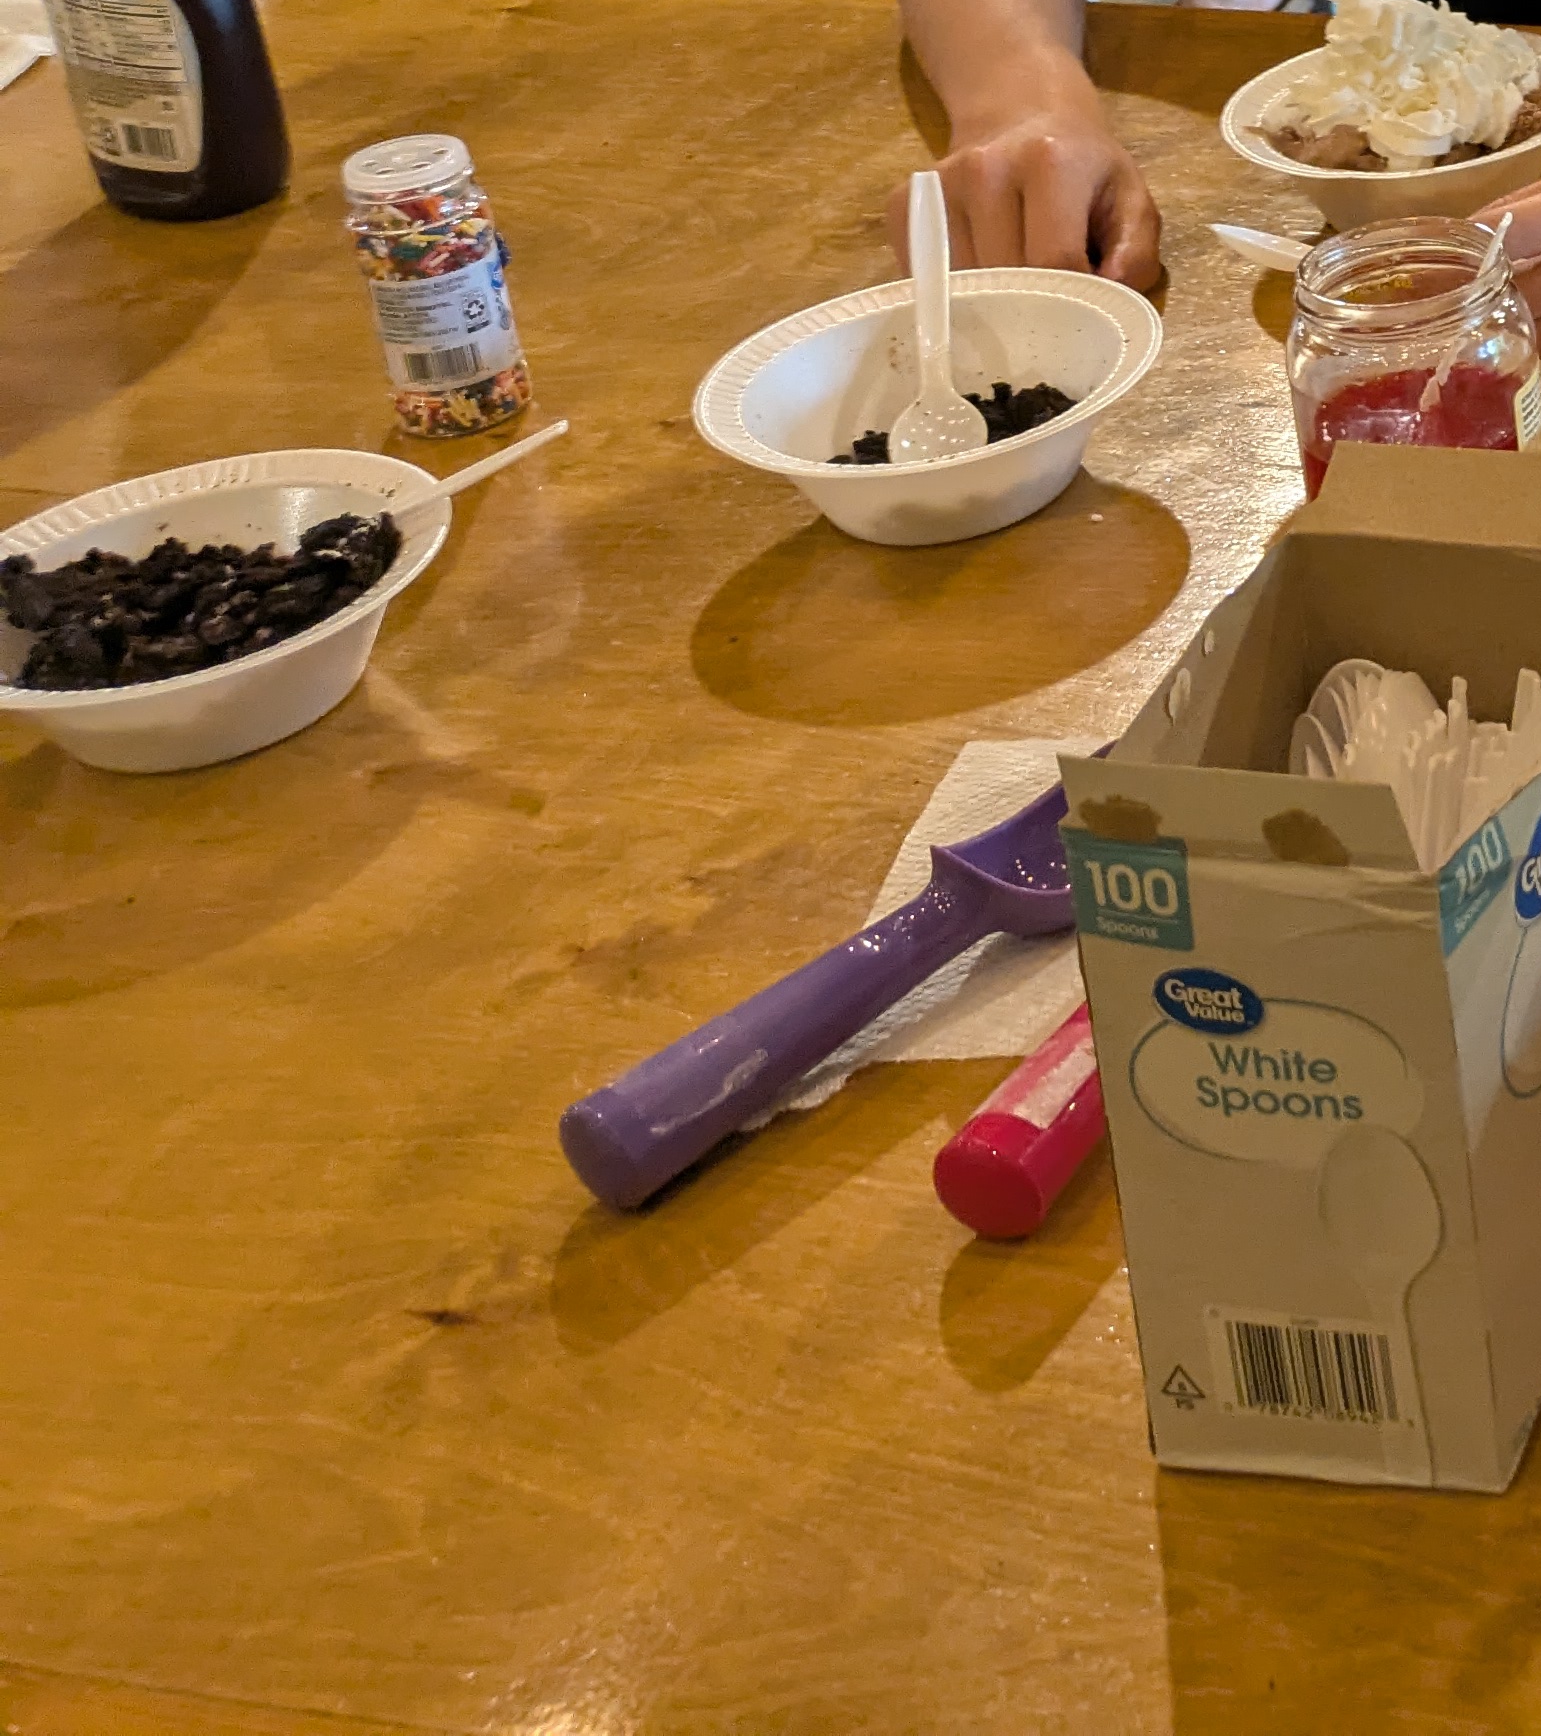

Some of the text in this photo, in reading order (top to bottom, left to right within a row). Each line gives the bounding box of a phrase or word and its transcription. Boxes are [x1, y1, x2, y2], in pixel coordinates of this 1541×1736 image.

[1084, 860, 1180, 917] 100
[1163, 977, 1244, 1011] Great
[1184, 1001, 1246, 1024] Value
[1208, 1041, 1338, 1084] White
[1196, 1075, 1364, 1120] Spoons
